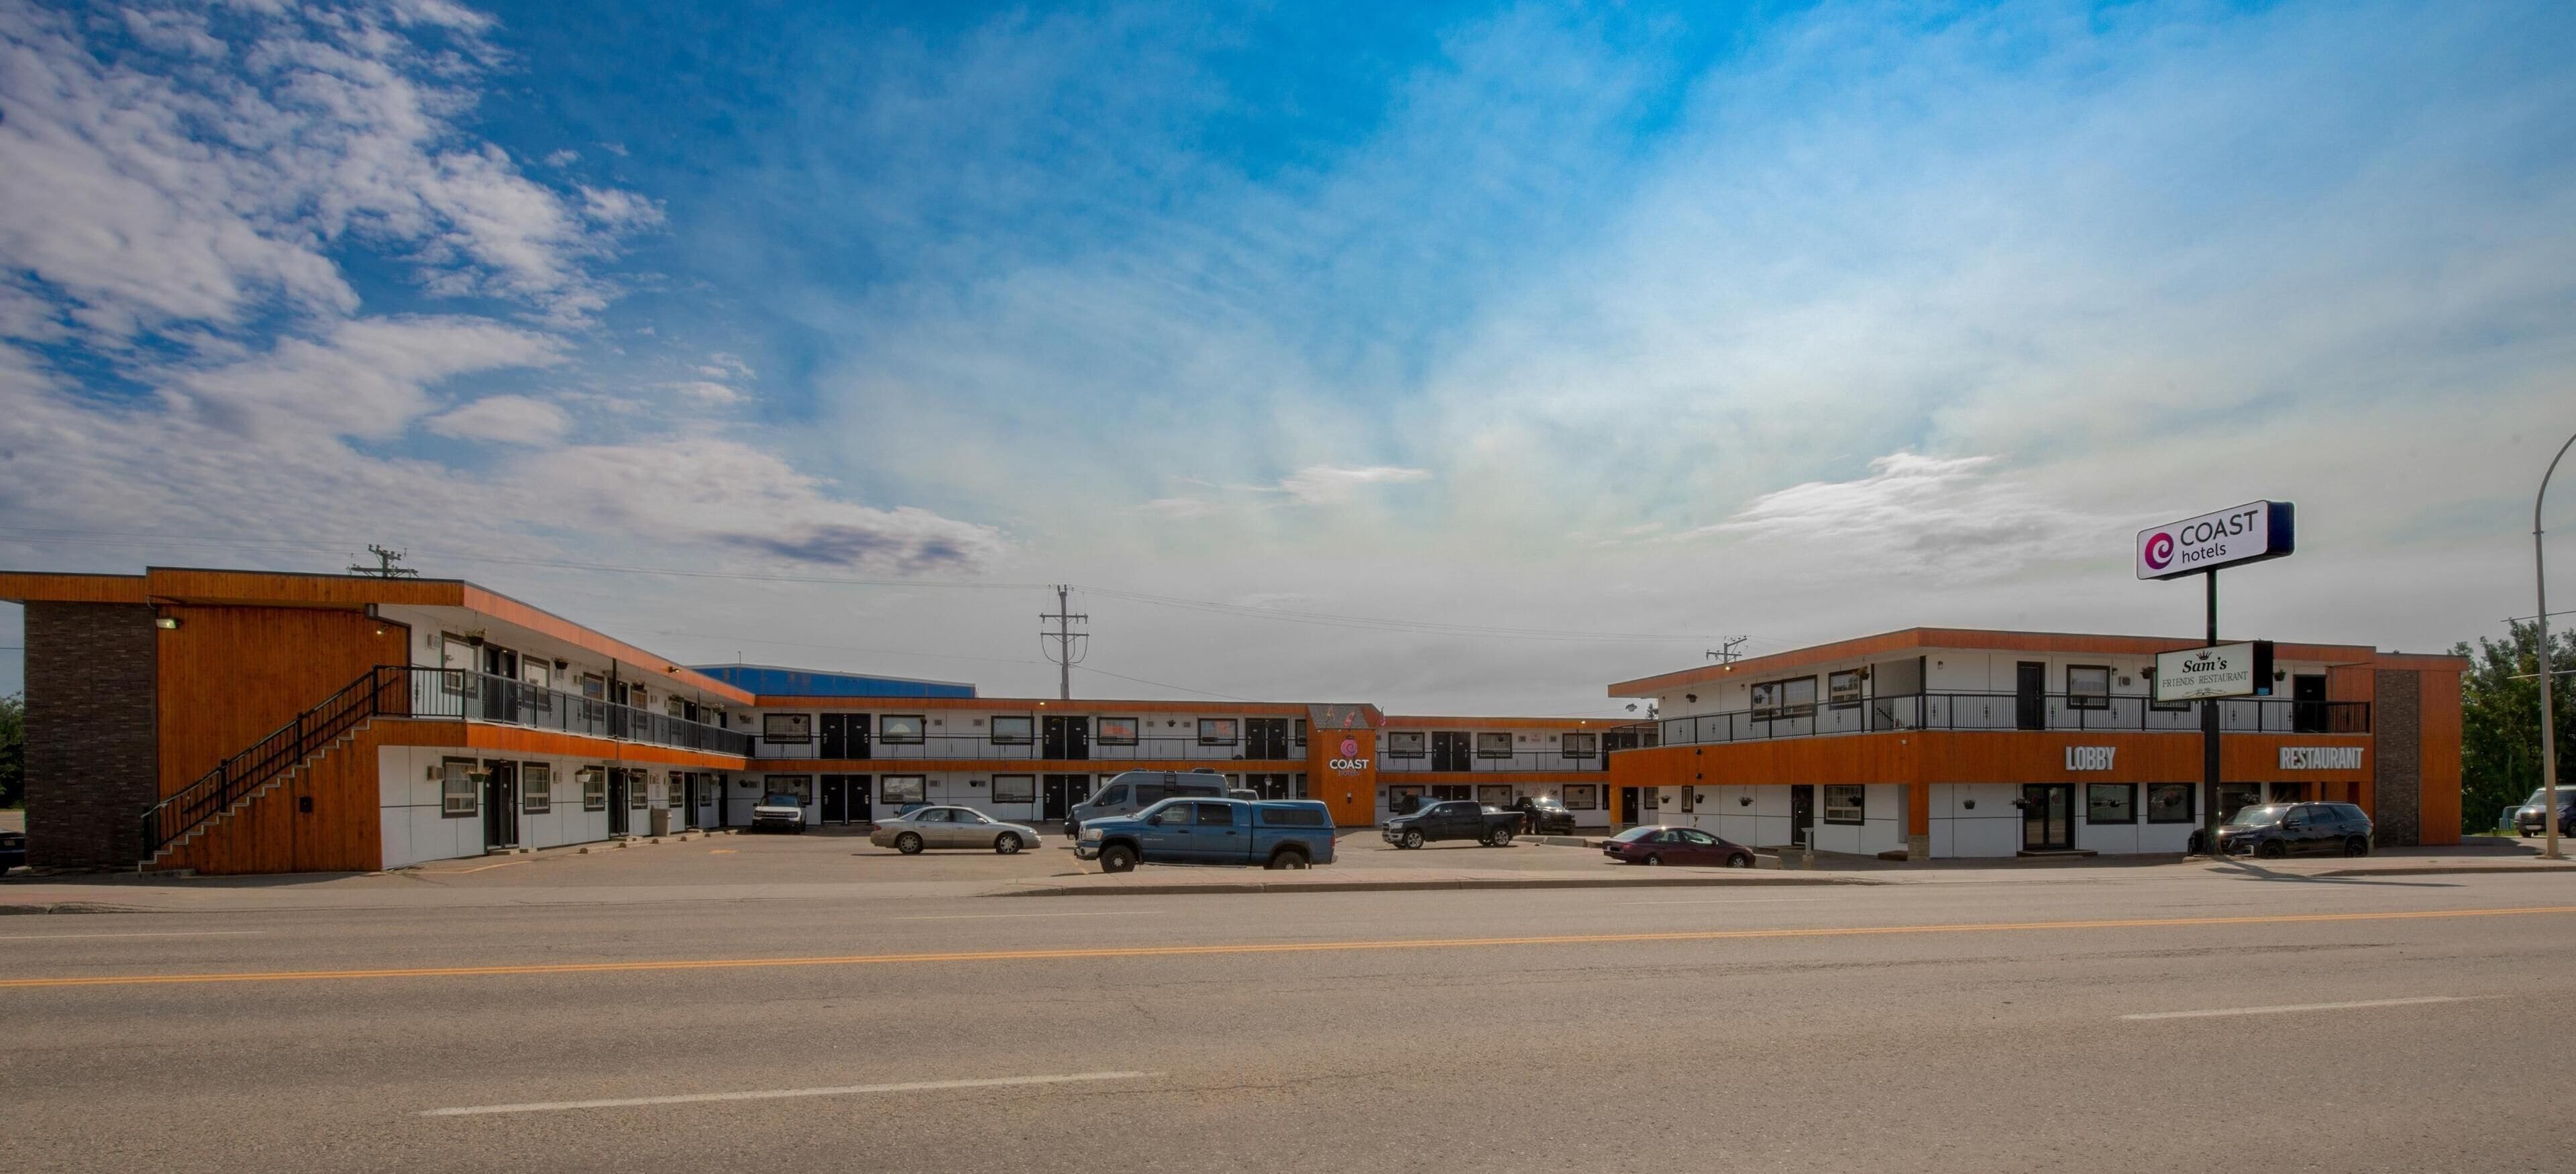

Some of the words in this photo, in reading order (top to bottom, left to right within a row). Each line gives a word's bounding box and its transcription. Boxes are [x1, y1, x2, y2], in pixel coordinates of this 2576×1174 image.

[2181, 510, 2258, 546] COAST
[2182, 543, 2226, 564] hotels
[2182, 657, 2227, 674] Sam's
[2162, 677, 2194, 688] FRIENDS
[2199, 671, 2248, 684] RESTAURANT
[1330, 759, 1369, 769] COAST
[2065, 747, 2116, 770] LOBBY
[2279, 747, 2364, 769] RESTAURANT
